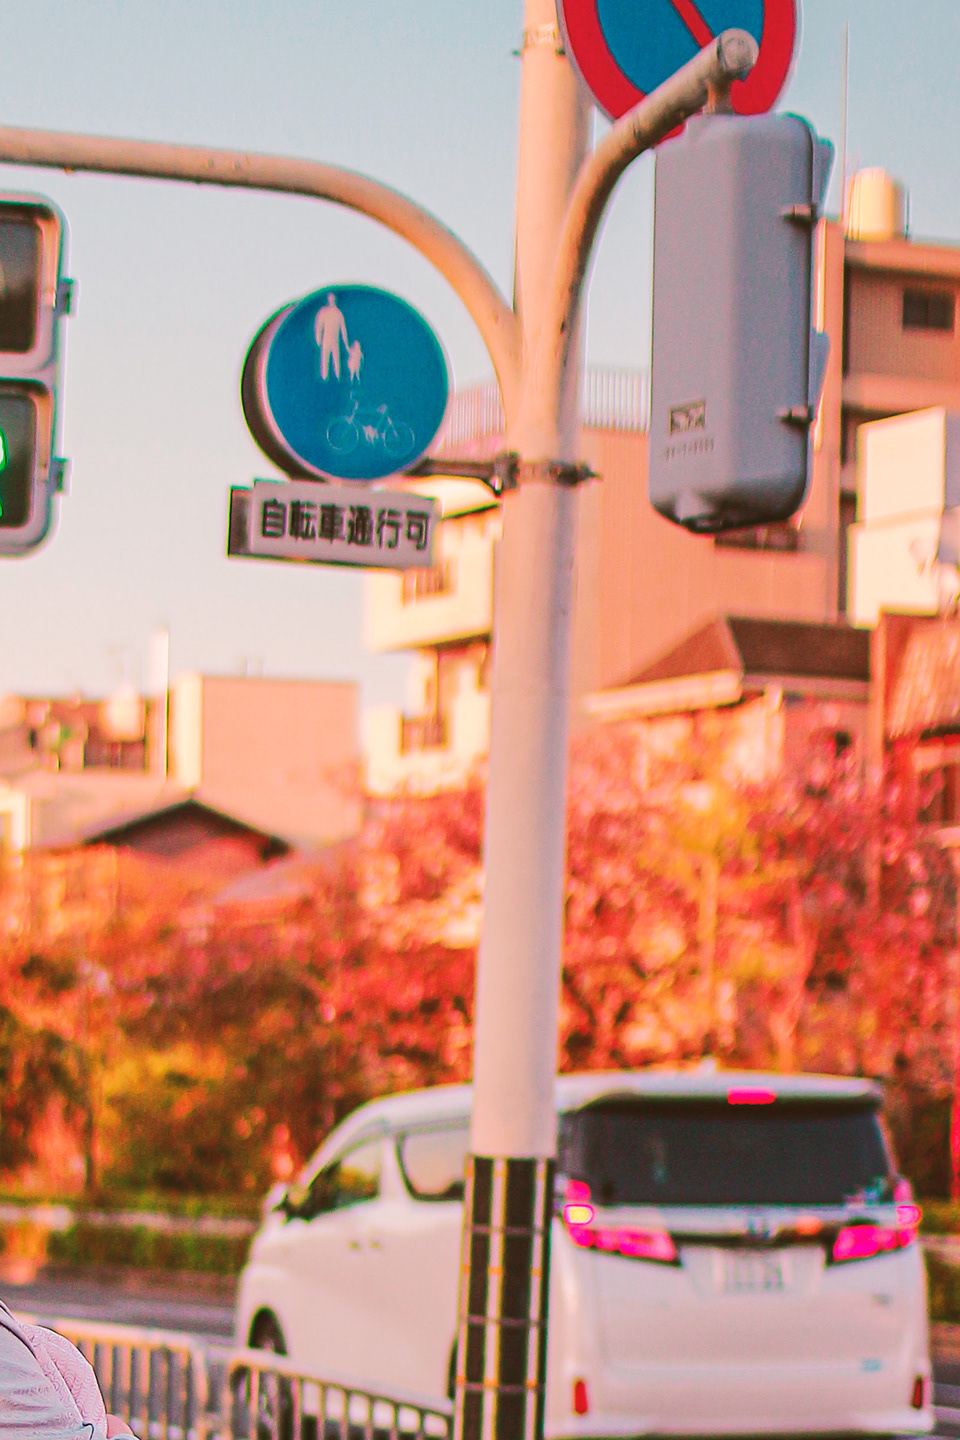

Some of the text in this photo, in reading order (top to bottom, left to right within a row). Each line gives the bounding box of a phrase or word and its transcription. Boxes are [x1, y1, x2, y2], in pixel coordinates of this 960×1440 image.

[262, 498, 429, 550] 自転車通行可
